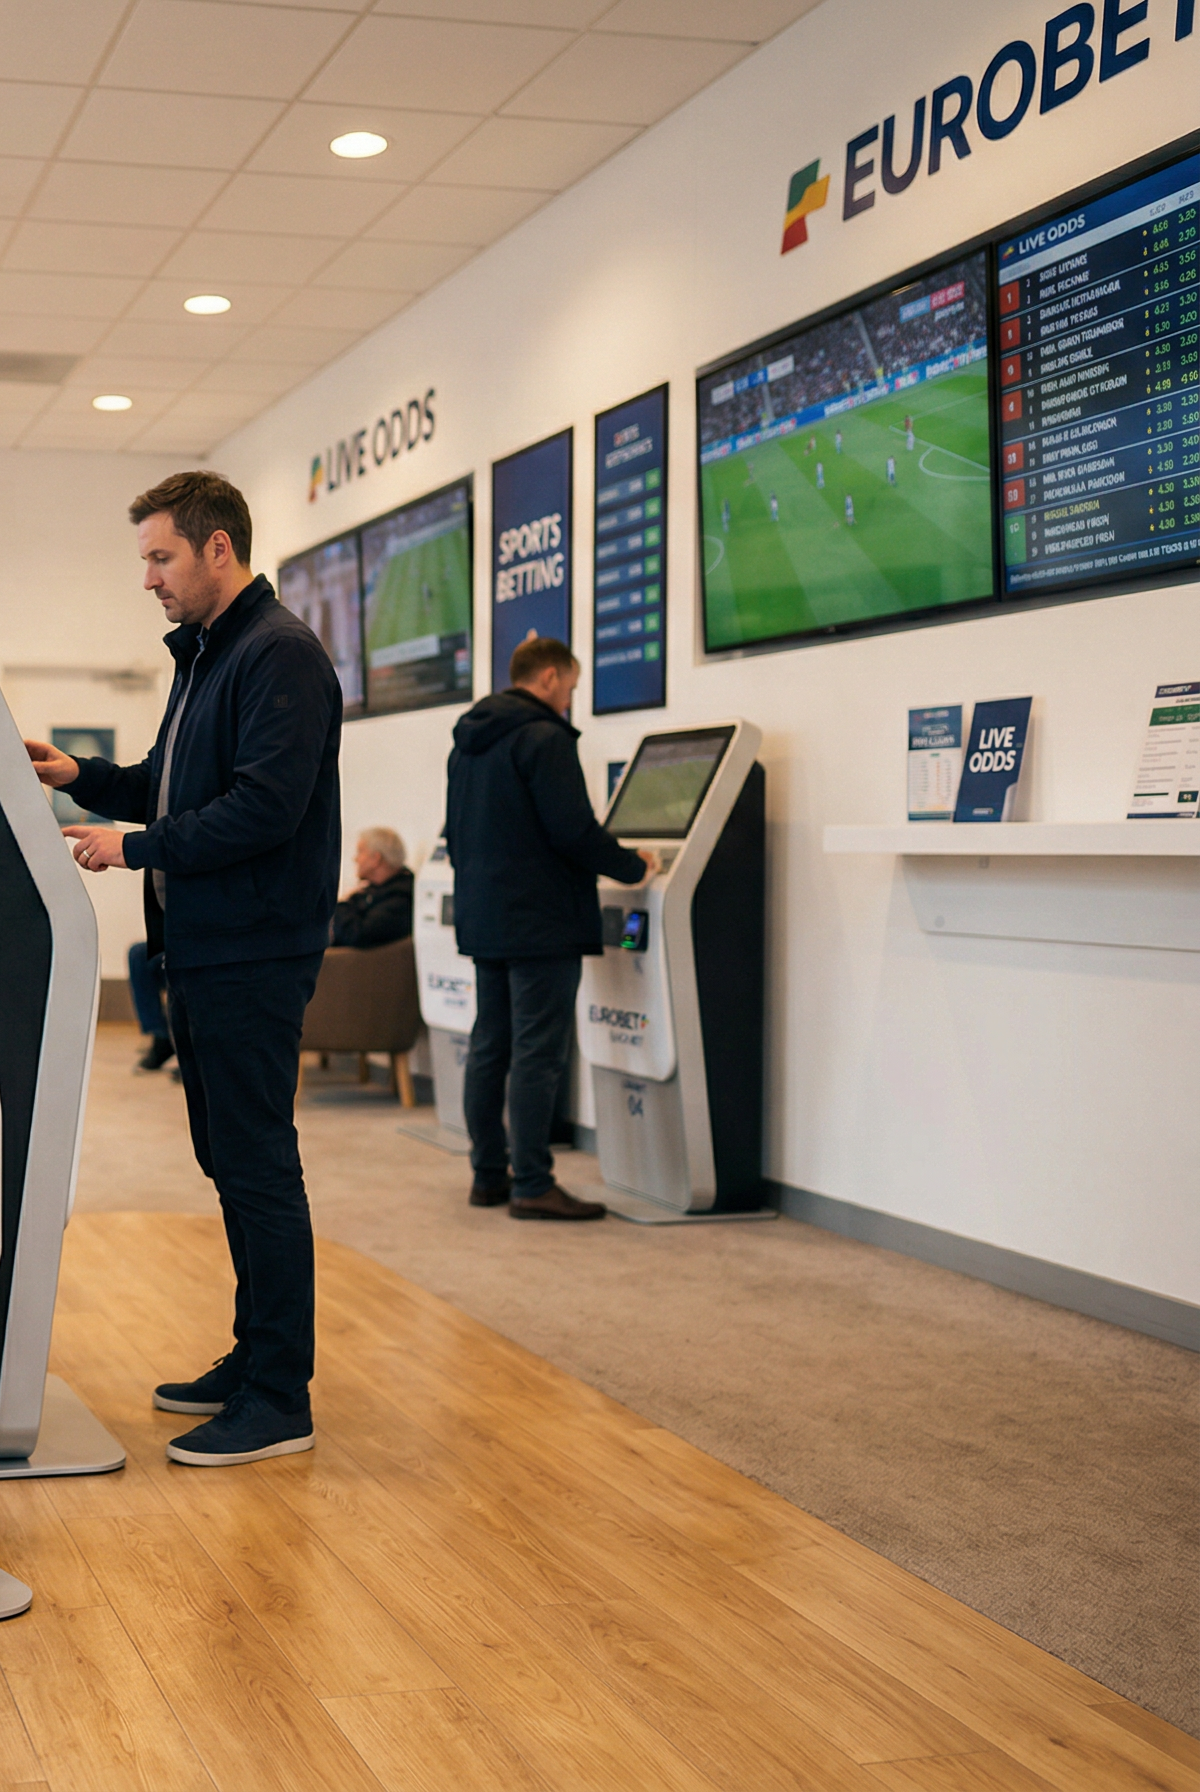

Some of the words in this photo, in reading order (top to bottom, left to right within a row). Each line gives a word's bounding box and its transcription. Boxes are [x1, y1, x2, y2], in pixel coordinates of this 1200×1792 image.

[1019, 231, 1046, 254] LIVE
[1047, 214, 1085, 241] ODDS
[327, 428, 367, 491] LIVE
[373, 387, 435, 467] ODDS
[499, 513, 562, 564] SPORTS
[496, 552, 564, 604] BETTING
[978, 726, 1016, 750] LIVE
[969, 750, 1016, 773] ODDS
